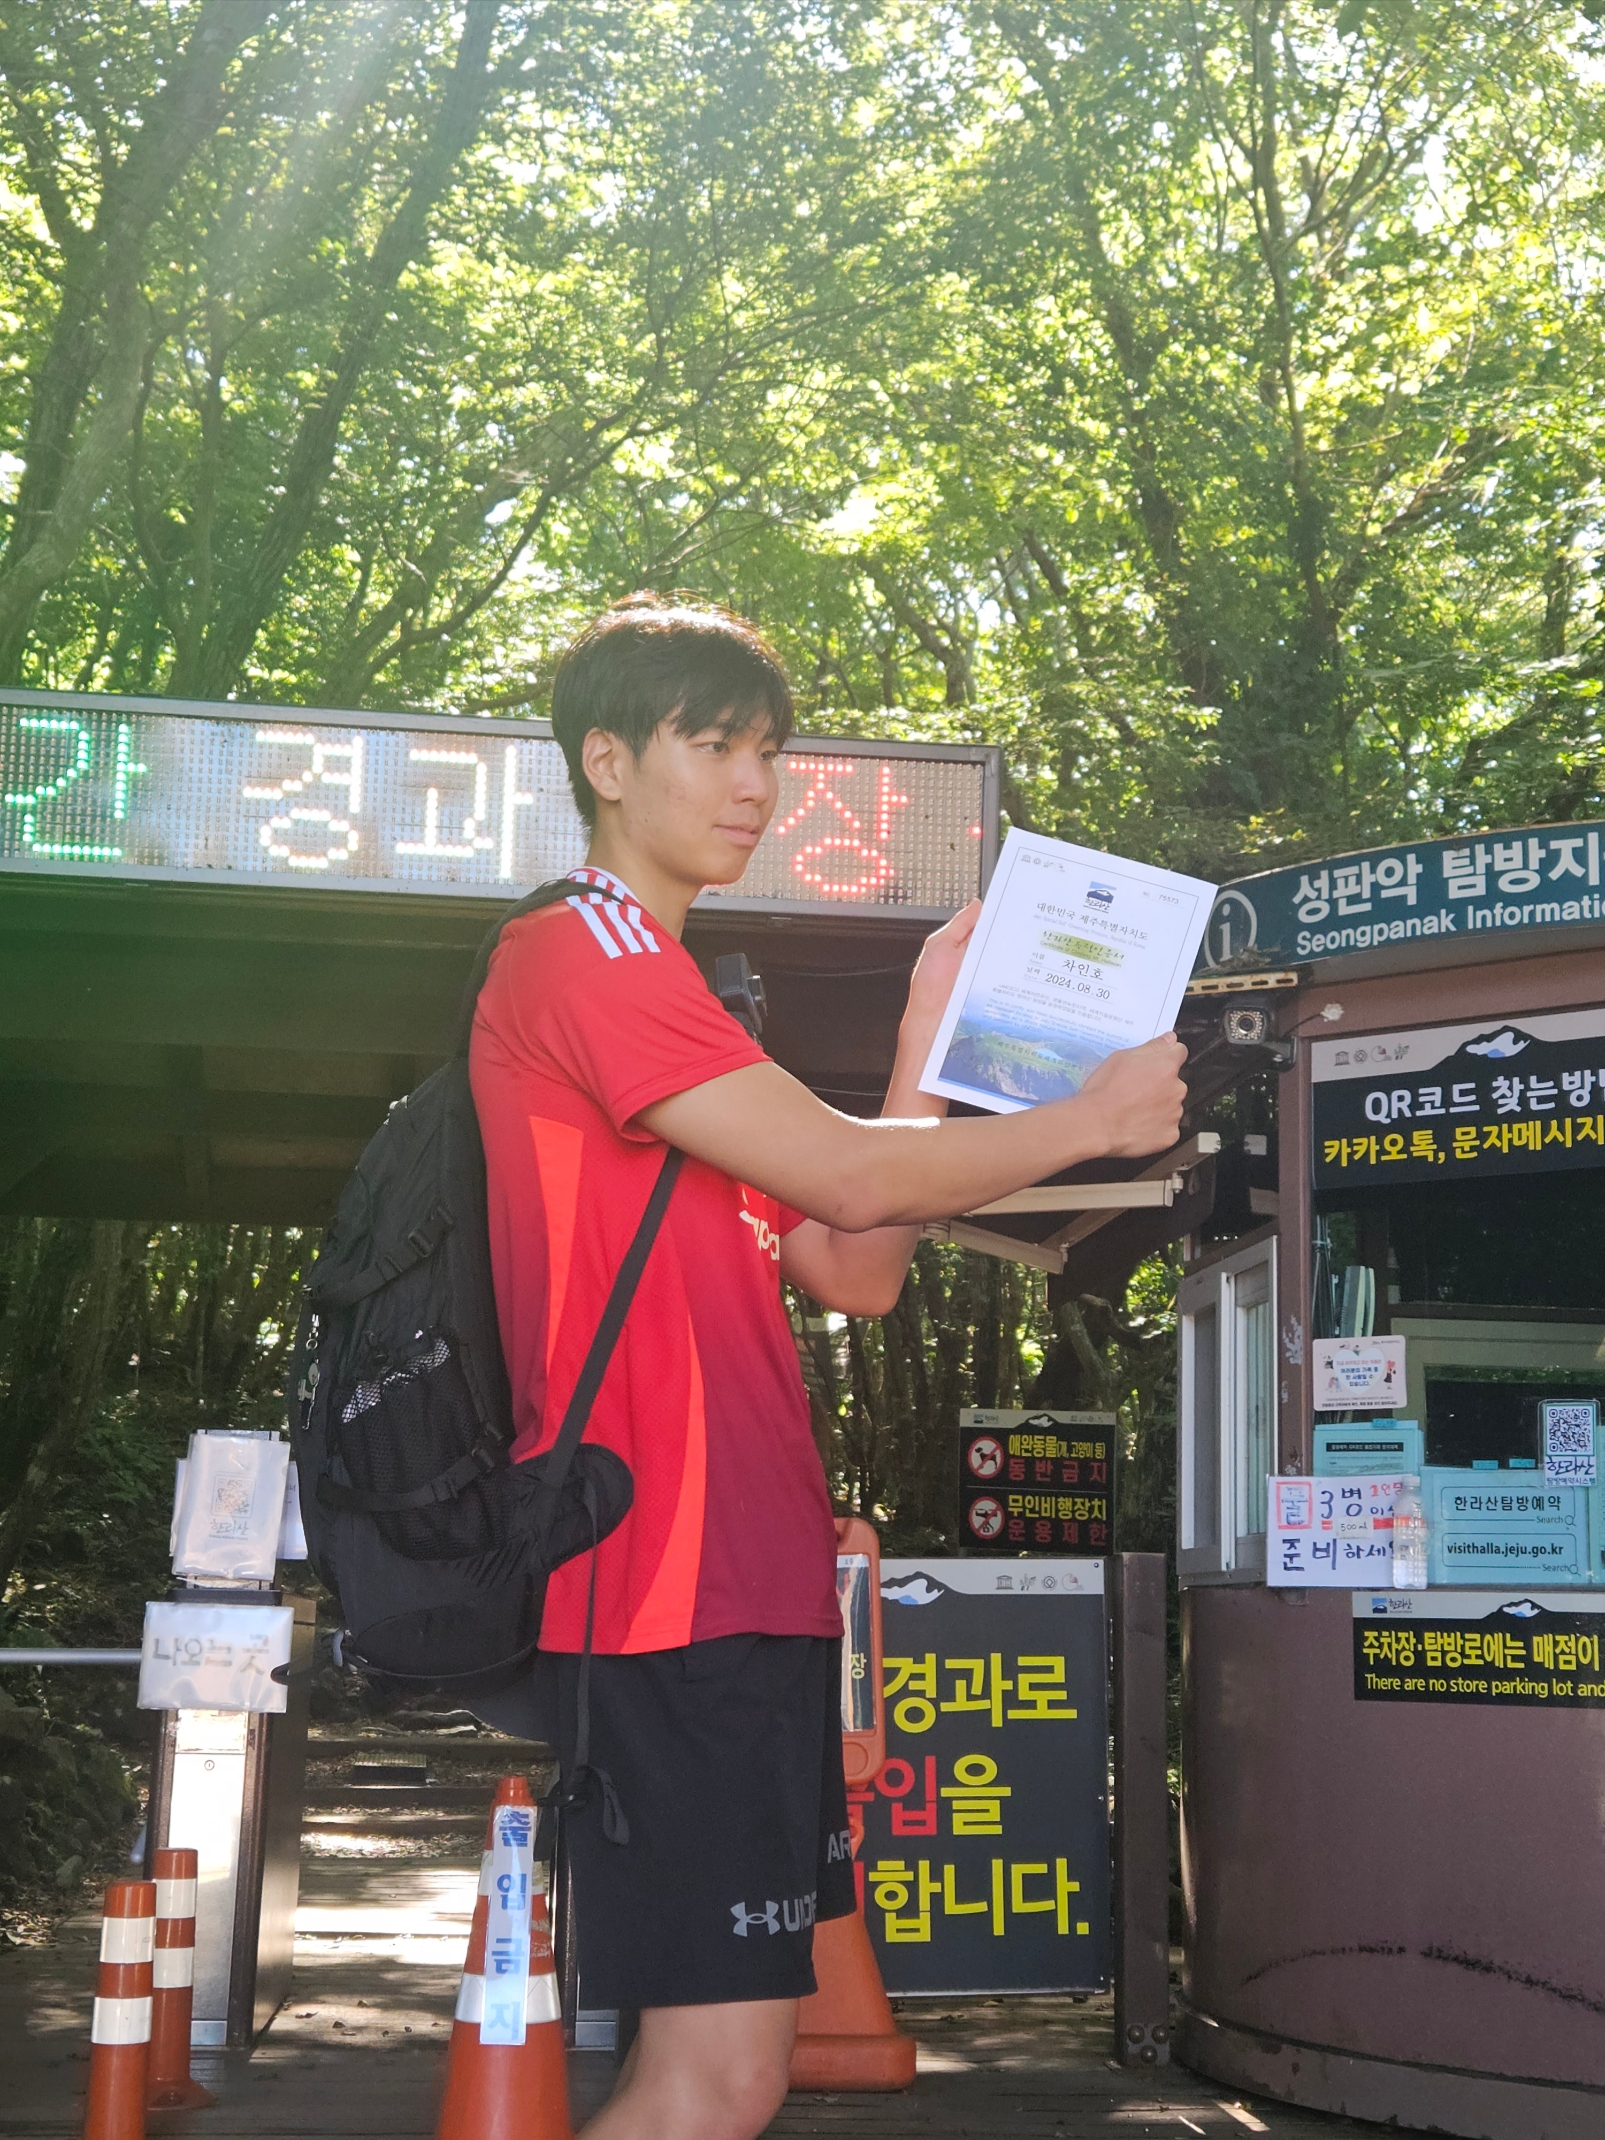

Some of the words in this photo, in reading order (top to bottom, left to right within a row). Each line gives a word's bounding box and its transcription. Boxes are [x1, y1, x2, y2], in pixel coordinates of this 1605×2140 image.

[243, 731, 533, 878] 경과
[1292, 853, 1423, 923] 성판악
[1442, 831, 1605, 899] 탐방지
[1157, 893, 1179, 905] 75573
[1036, 900, 1076, 921] 대한민국
[1078, 912, 1149, 942] 제주특별자치도
[1296, 909, 1457, 955] Seongpanak
[1061, 957, 1106, 981] 차인호
[1365, 1083, 1480, 1124] QR코드
[1547, 1456, 1595, 1475] 한라산
[1008, 1494, 1106, 1521] 무인비행장치
[1454, 1496, 1562, 1512] 한라산탐방예약
[1536, 1515, 1564, 1524] Search
[1447, 1542, 1564, 1558] visithalla.jeju.go.kr
[1542, 1563, 1570, 1573] Search
[1388, 1597, 1413, 1610] 한라산
[1362, 1630, 1526, 1668] 주차장·탐방로에는
[1532, 1633, 1600, 1671] 매점이
[882, 1652, 1077, 1733] 경과로
[1365, 1673, 1401, 1691] There
[1404, 1680, 1426, 1691] are
[1429, 1680, 1446, 1692] no
[1450, 1678, 1487, 1693] store
[1491, 1677, 1548, 1698] parking
[1552, 1678, 1574, 1696] lot
[1577, 1679, 1605, 1697] and
